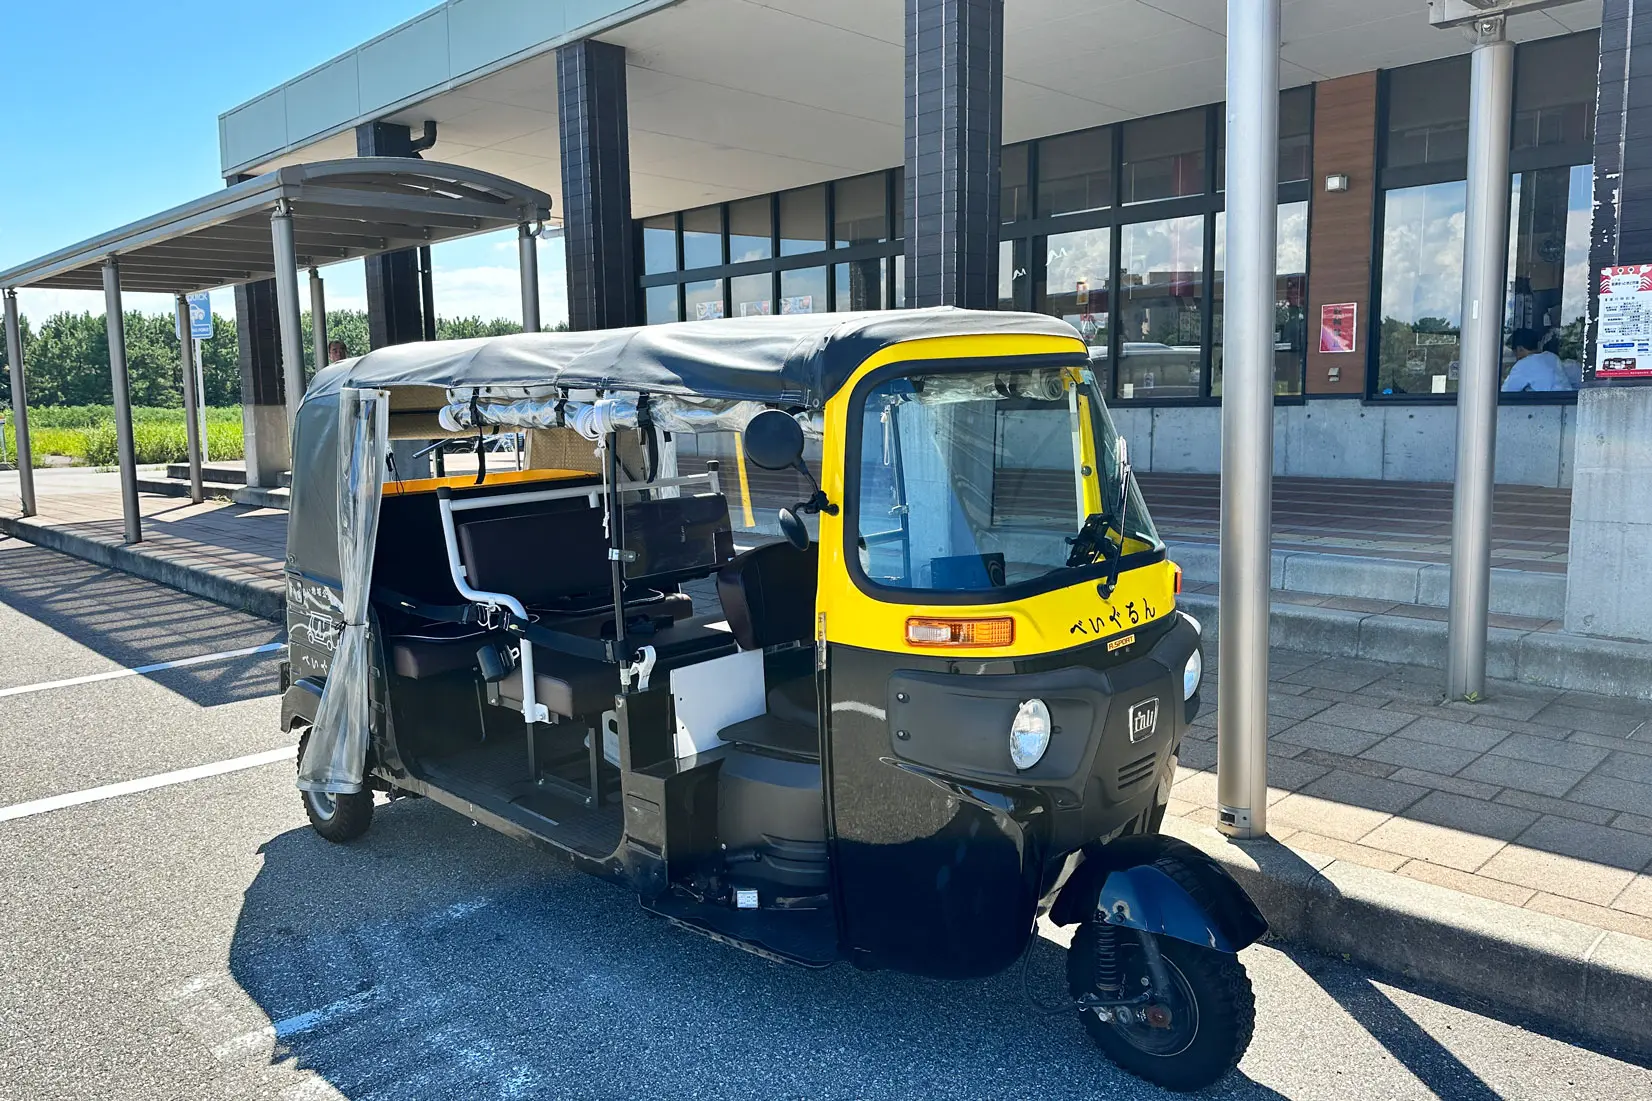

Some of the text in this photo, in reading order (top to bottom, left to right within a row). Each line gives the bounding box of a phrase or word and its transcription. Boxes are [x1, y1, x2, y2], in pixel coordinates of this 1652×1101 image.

[1070, 598, 1156, 635] べいぐるん
